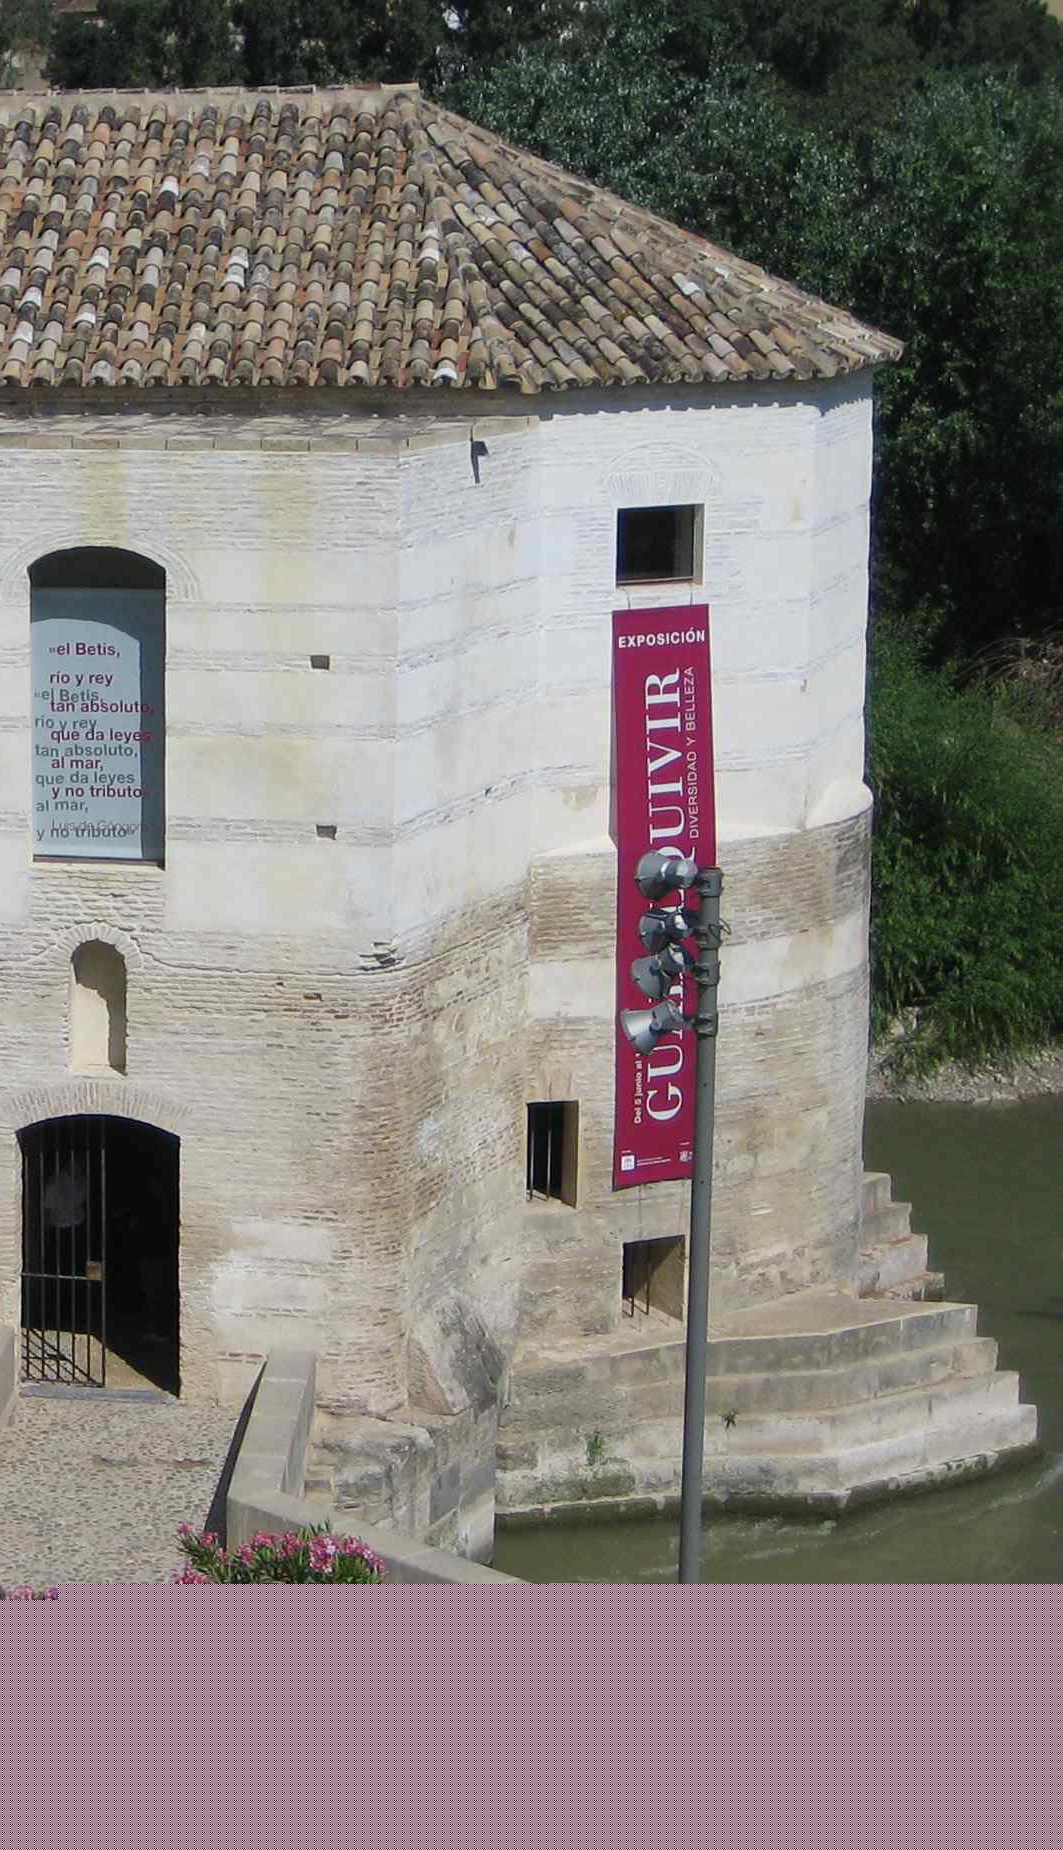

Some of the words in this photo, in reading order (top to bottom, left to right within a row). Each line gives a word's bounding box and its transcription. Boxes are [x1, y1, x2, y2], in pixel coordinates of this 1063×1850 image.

[618, 627, 706, 648] EXPOSICIÓN
[75, 642, 121, 658] Betis,
[75, 674, 84, 687] y
[88, 674, 113, 687] rey
[683, 666, 696, 731] BELLEZA
[50, 700, 75, 713] tan
[51, 730, 80, 743] que
[85, 728, 105, 741] da
[685, 736, 697, 747] Y
[51, 756, 65, 769] al
[70, 759, 104, 771] mar,
[51, 787, 60, 799] y
[65, 787, 84, 797] no
[686, 751, 700, 839] DIVERSIDAD
